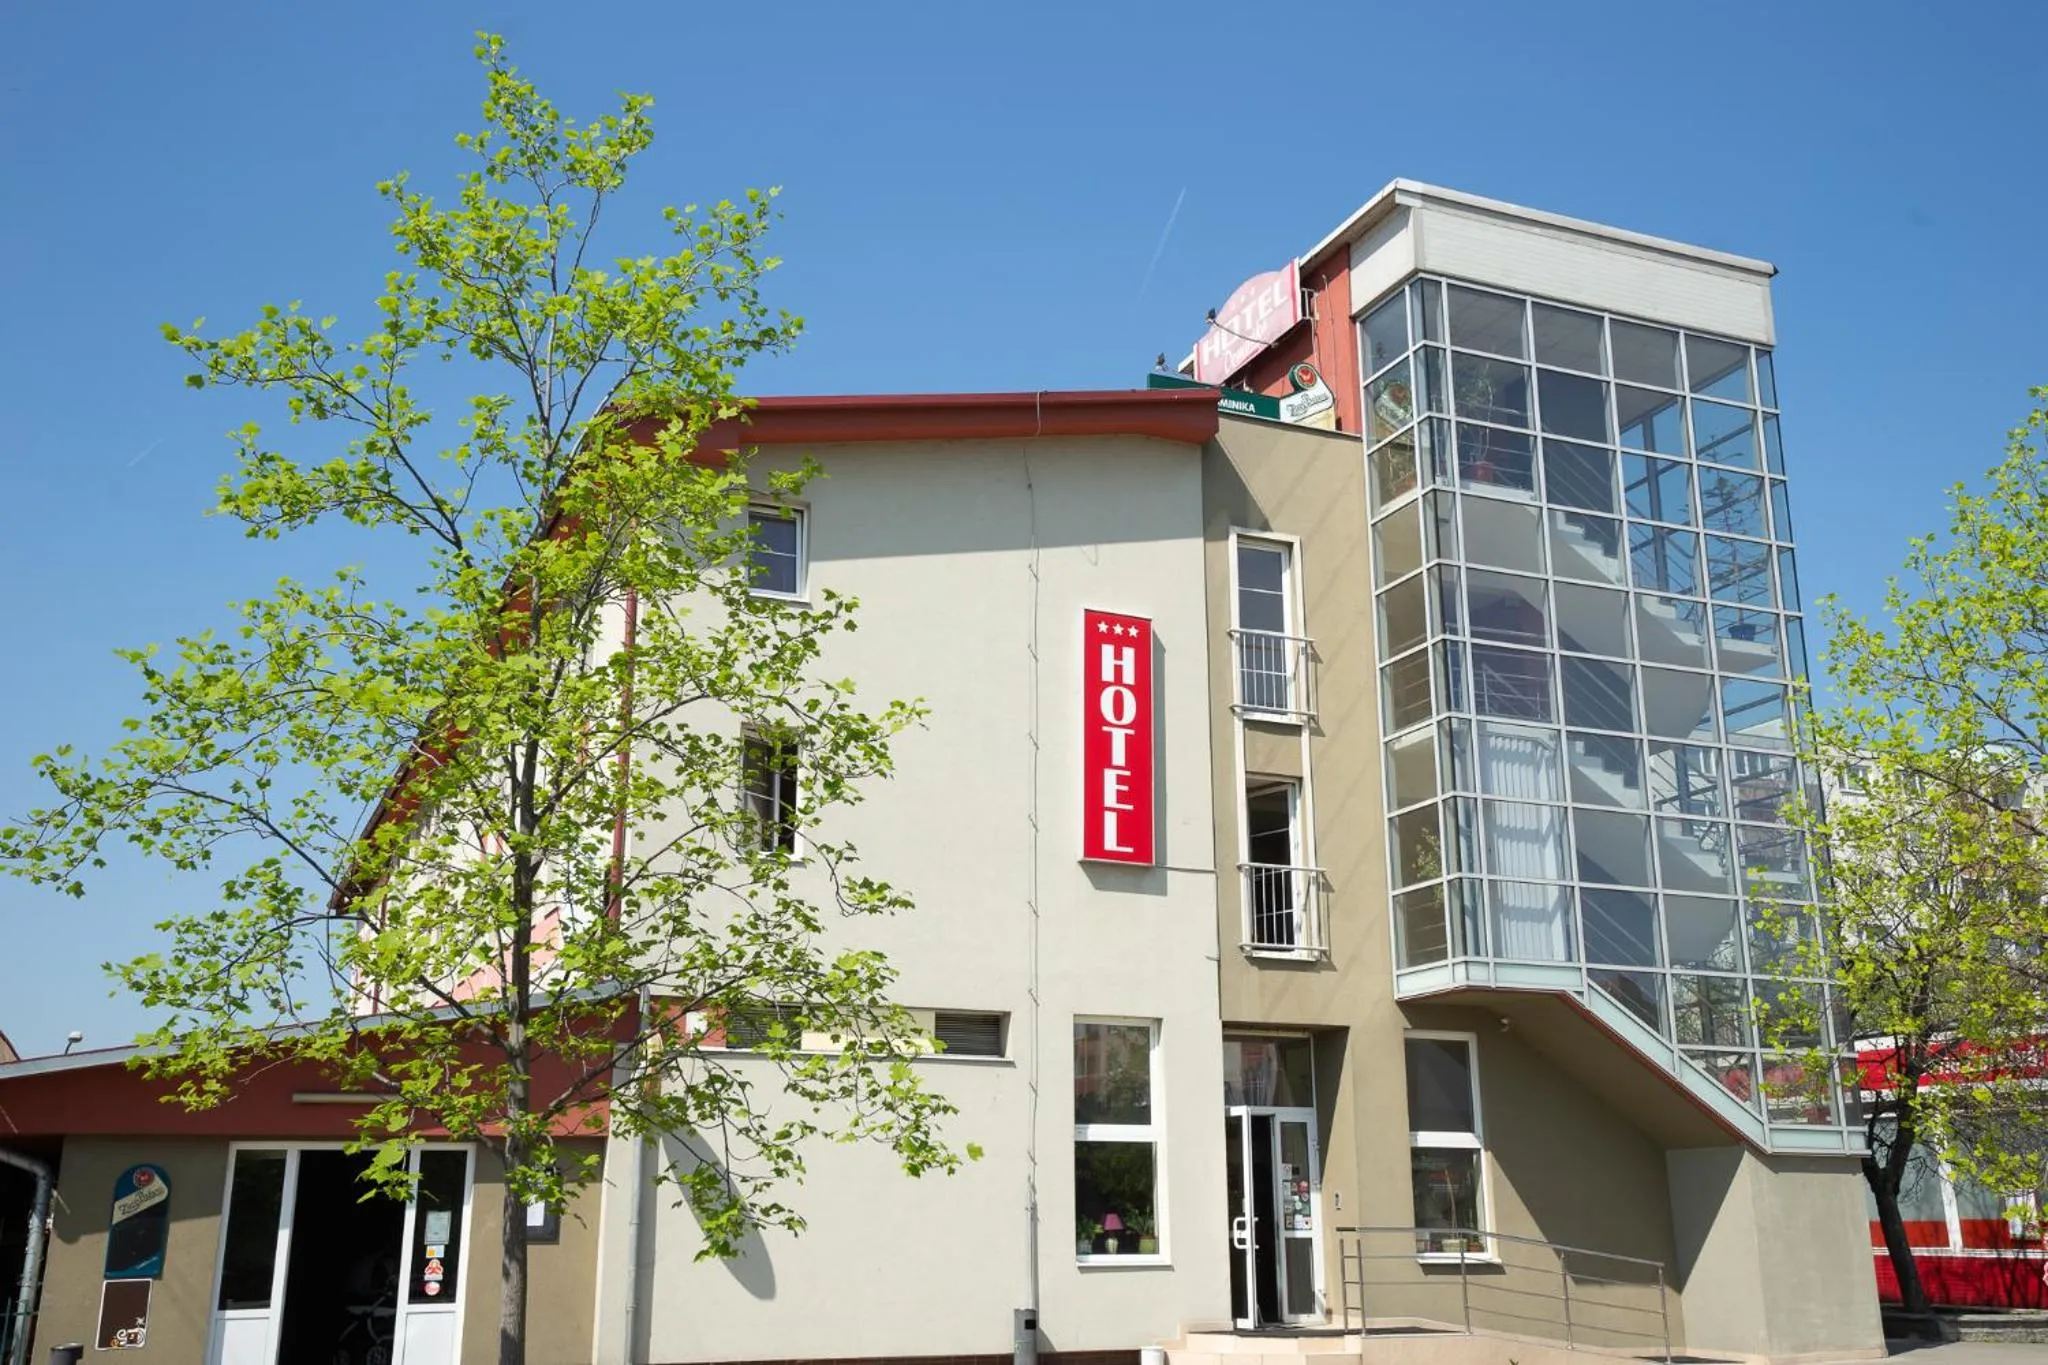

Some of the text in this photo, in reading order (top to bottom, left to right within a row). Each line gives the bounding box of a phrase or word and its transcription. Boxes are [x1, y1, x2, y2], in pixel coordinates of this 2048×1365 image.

[1202, 279, 1289, 366] HOTEL
[1218, 398, 1256, 413] MINIKA
[1099, 643, 1137, 853] HOTEL
